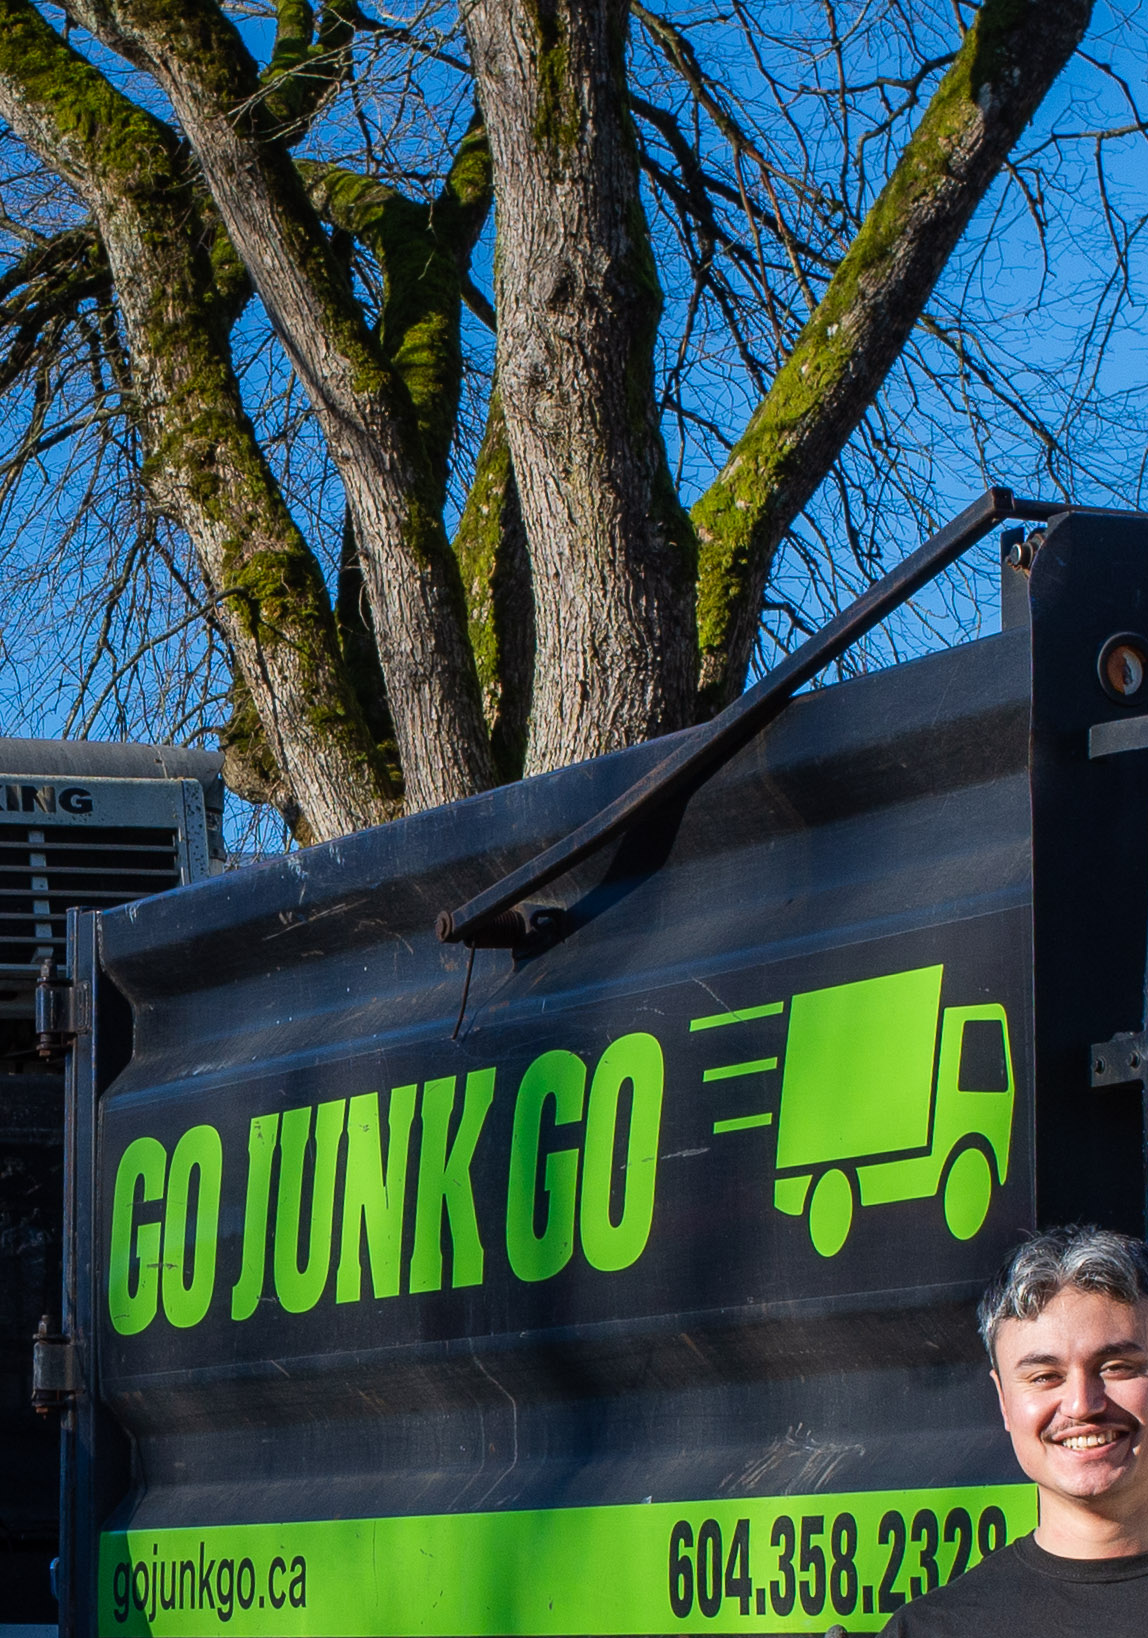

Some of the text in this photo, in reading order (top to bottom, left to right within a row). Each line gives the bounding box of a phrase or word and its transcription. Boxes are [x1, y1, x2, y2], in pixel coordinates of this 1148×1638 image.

[0, 785, 93, 814] ING
[108, 1031, 665, 1336] GO JUNK GO
[113, 1541, 308, 1623] gojunkgo.ca
